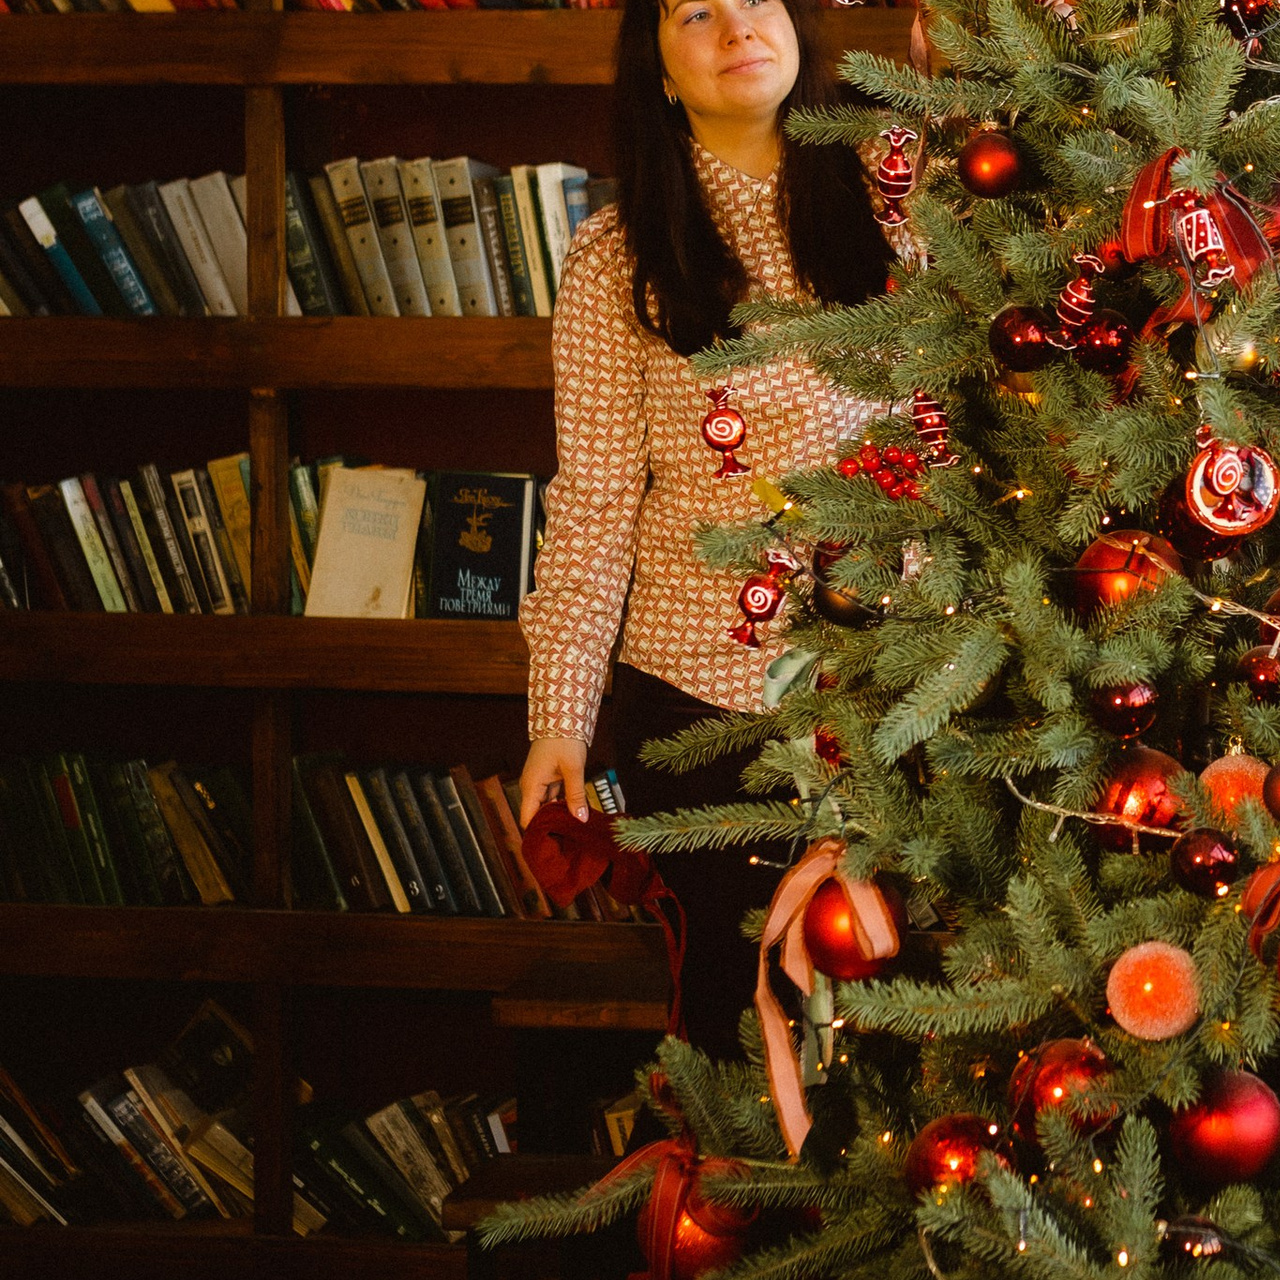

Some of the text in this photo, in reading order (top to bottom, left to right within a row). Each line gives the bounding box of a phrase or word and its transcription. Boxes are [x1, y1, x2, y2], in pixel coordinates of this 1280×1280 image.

[459, 587, 493, 604] ТРЕМЯ
[439, 597, 512, 617] ПОВЕТРИЯМИ
[407, 880, 421, 896] 3
[434, 884, 446, 901] 2
